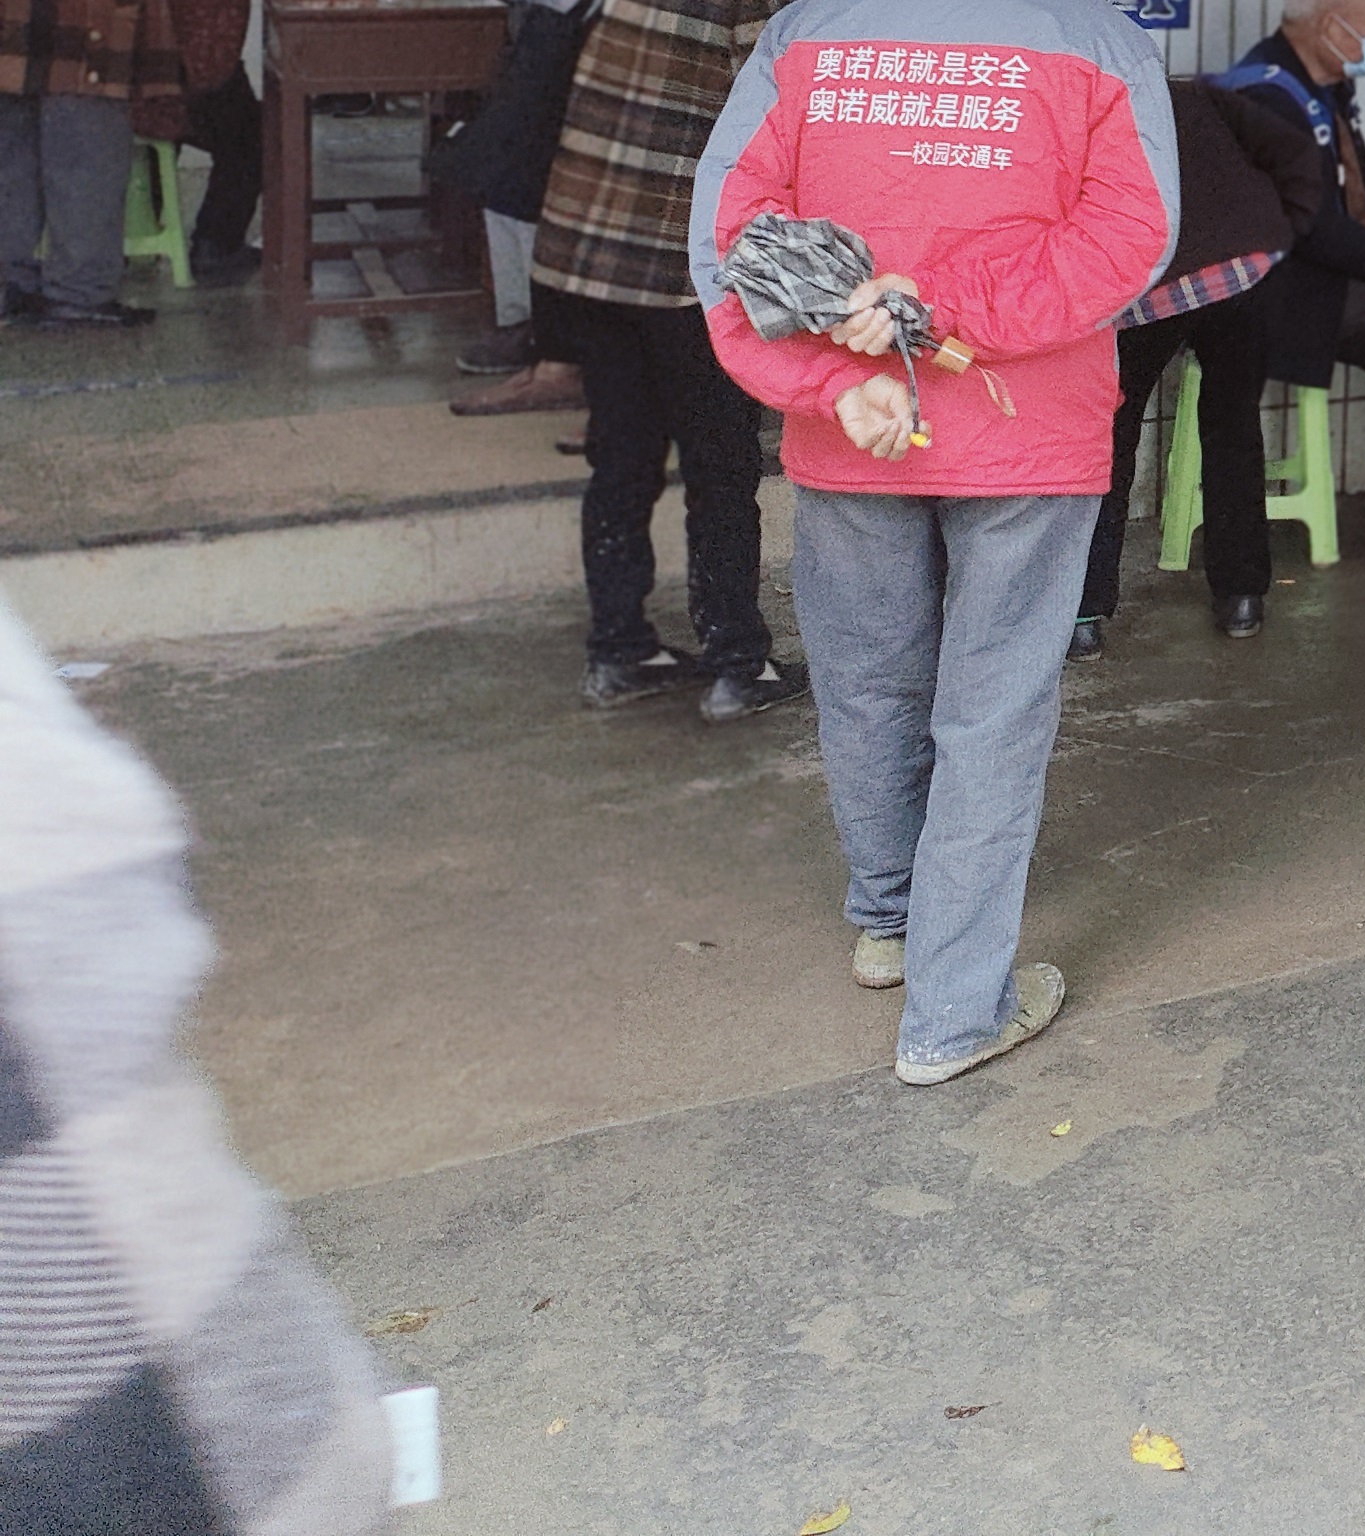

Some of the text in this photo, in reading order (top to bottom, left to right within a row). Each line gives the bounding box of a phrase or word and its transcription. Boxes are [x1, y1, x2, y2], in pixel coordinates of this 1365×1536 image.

[812, 47, 1032, 90] 奥诺威就是安全
[805, 88, 1025, 133] 奥诺威就是服务
